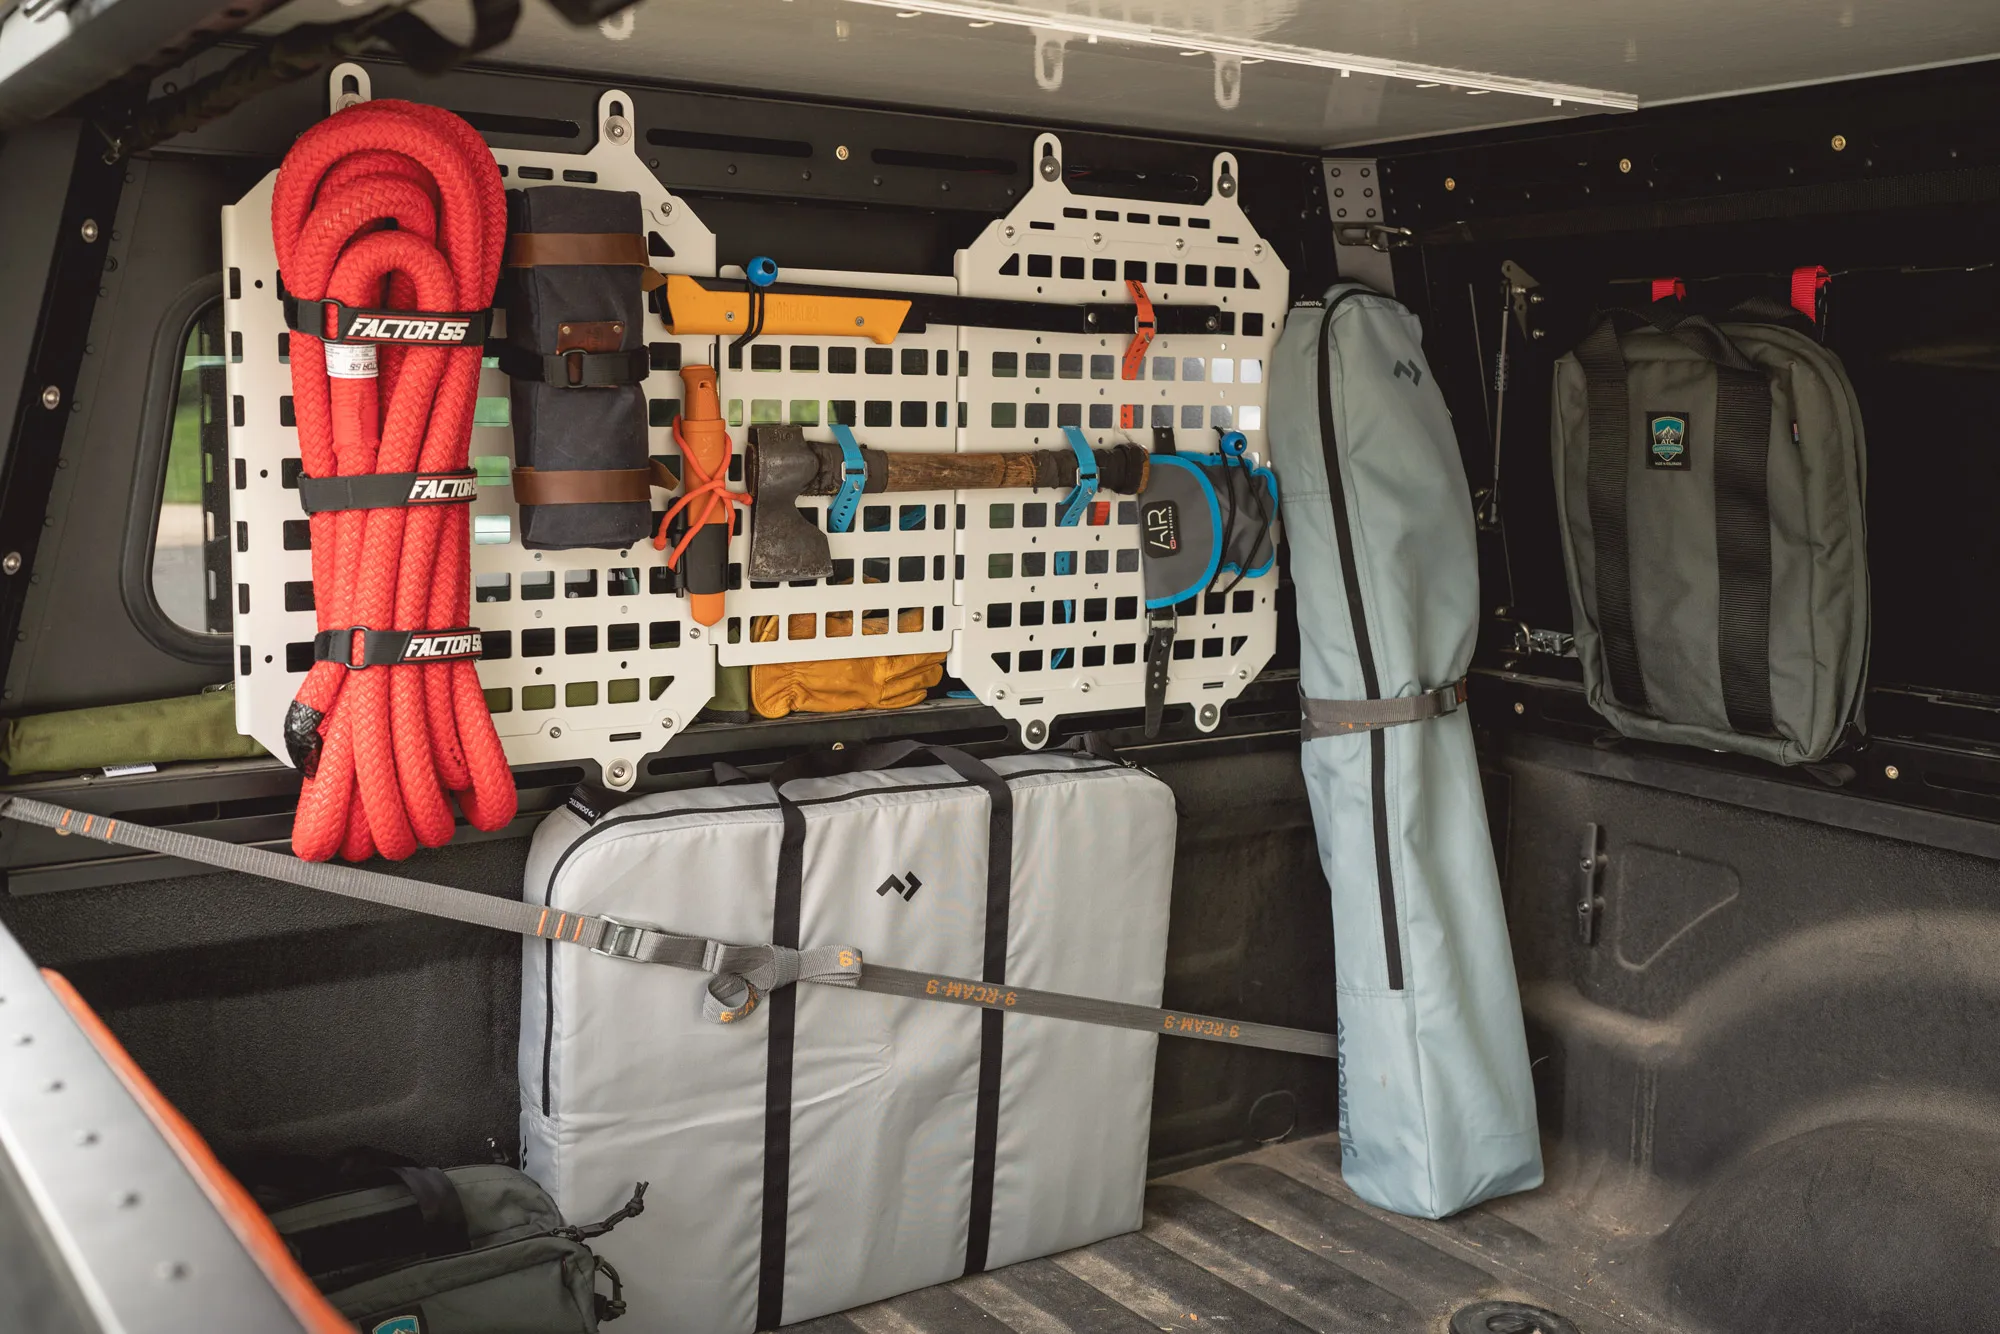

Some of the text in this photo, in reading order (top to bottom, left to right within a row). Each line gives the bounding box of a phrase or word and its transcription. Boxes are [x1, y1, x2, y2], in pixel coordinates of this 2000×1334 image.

[347, 317, 470, 341] FACTOR 55
[409, 478, 473, 499] FACTOR
[1147, 508, 1170, 549] AIR
[405, 635, 472, 657] FACTOR
[1338, 1051, 1358, 1159] DOMETIC
